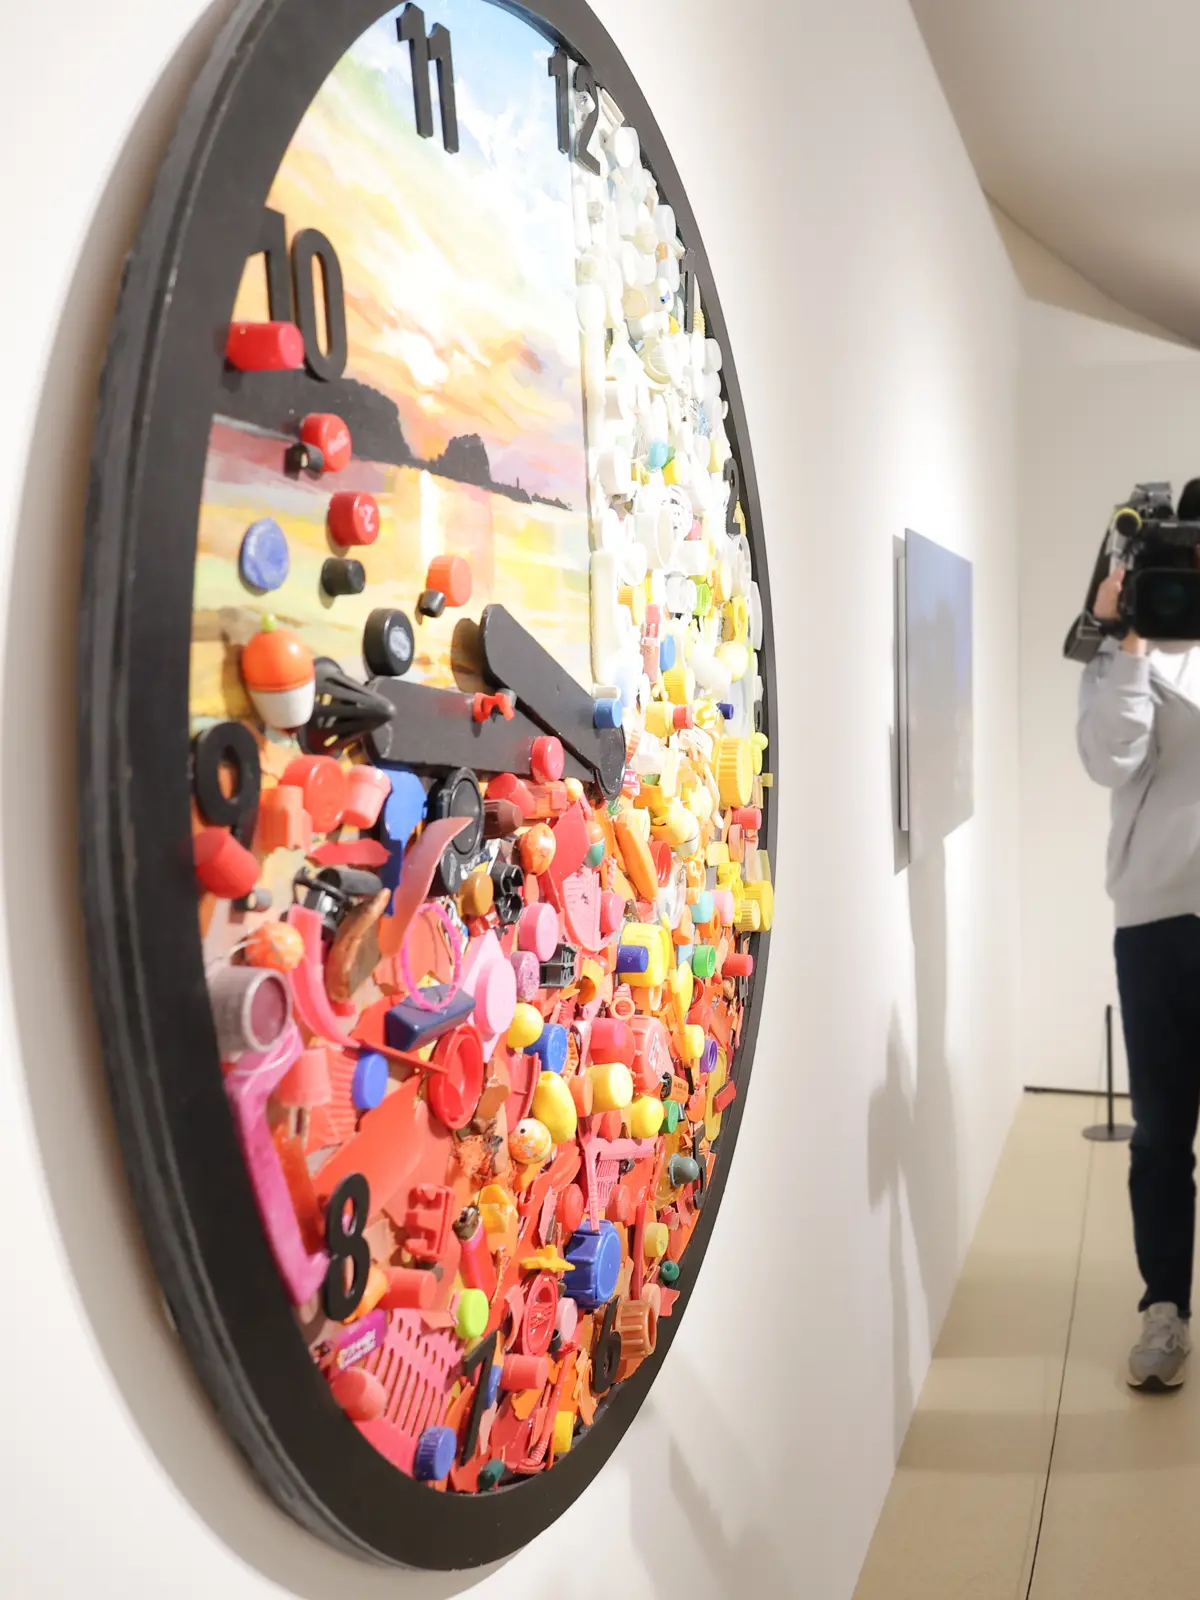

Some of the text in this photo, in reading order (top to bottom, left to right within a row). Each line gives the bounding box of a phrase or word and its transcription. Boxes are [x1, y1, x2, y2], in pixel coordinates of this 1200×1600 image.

[396, 3, 459, 154] 11
[548, 46, 600, 176] 12
[249, 206, 348, 383] 10
[723, 457, 741, 536] 2
[190, 721, 261, 851] 9
[324, 1172, 371, 1321] 8
[464, 1329, 499, 1466] 7
[590, 1294, 621, 1394] 6
